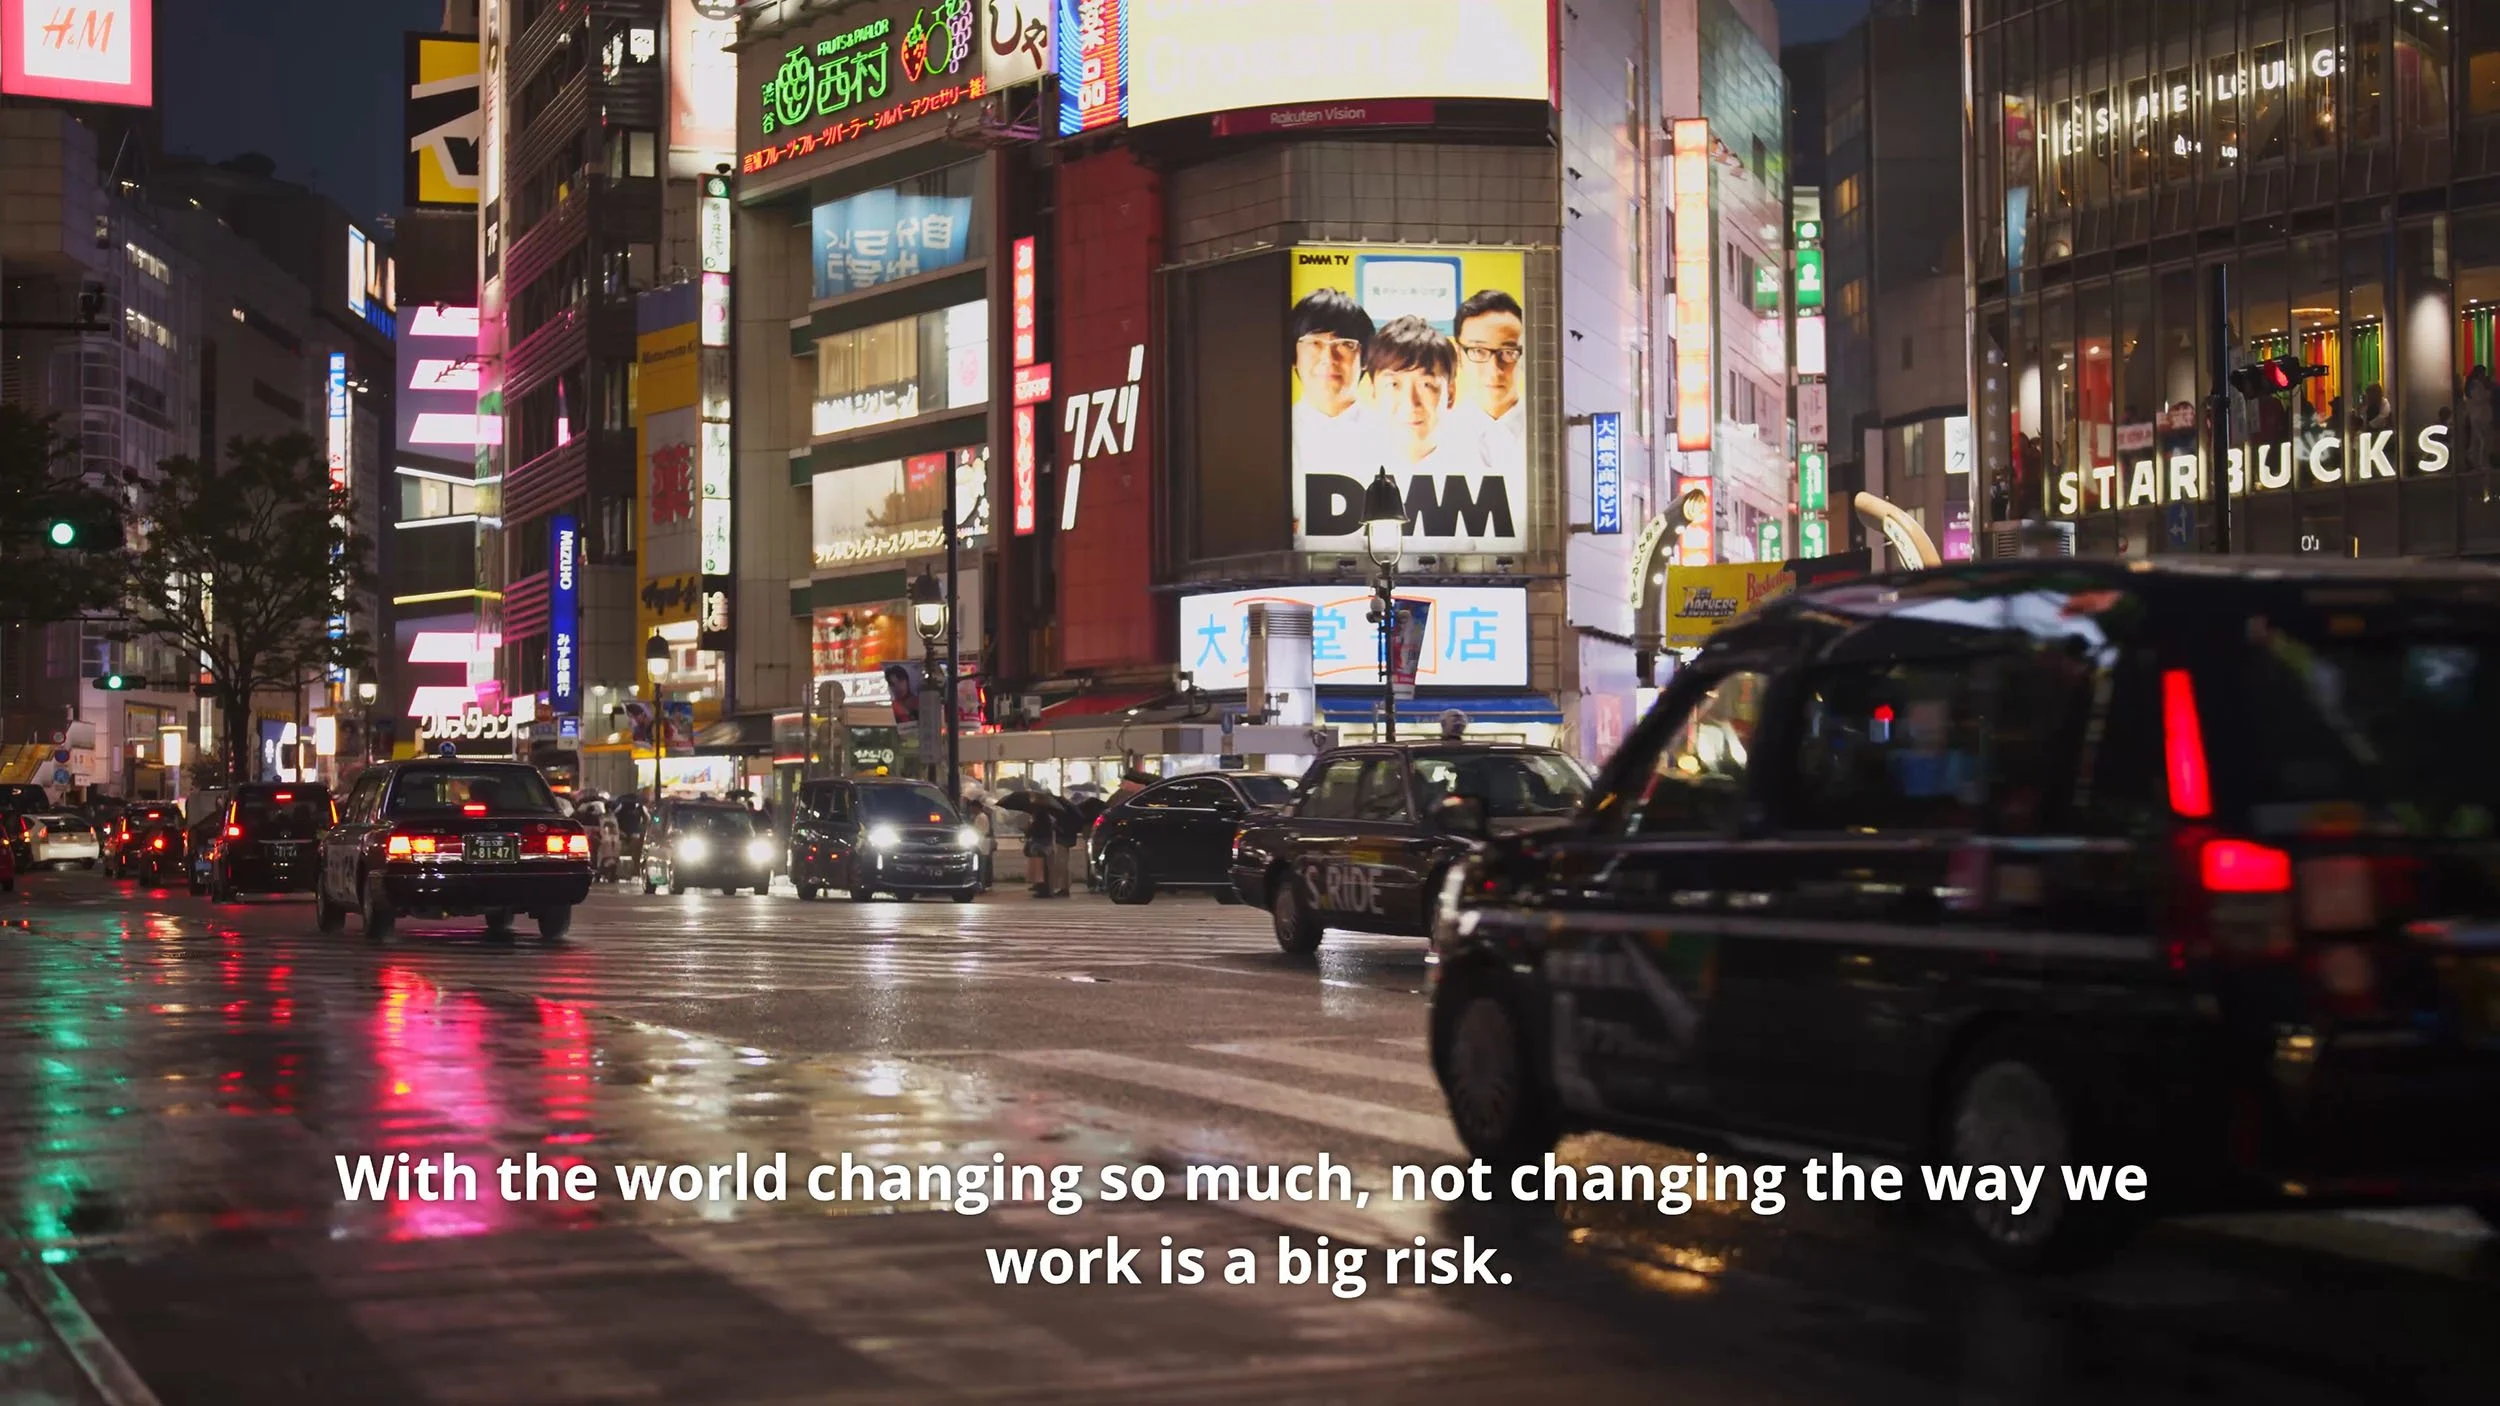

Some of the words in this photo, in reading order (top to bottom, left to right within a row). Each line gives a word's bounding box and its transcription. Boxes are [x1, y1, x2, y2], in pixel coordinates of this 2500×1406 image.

[42, 6, 116, 54] H&M
[816, 41, 889, 116] 西村
[761, 81, 776, 134] 渋谷
[1270, 111, 1322, 126] Rakuten
[1325, 106, 1366, 121] Vision
[1298, 254, 1331, 267] DMM
[1333, 254, 1350, 267] TV
[2058, 424, 2450, 515] STARBUCKS
[560, 530, 574, 591] MIZUHO
[1197, 606, 1499, 668] 大堂店
